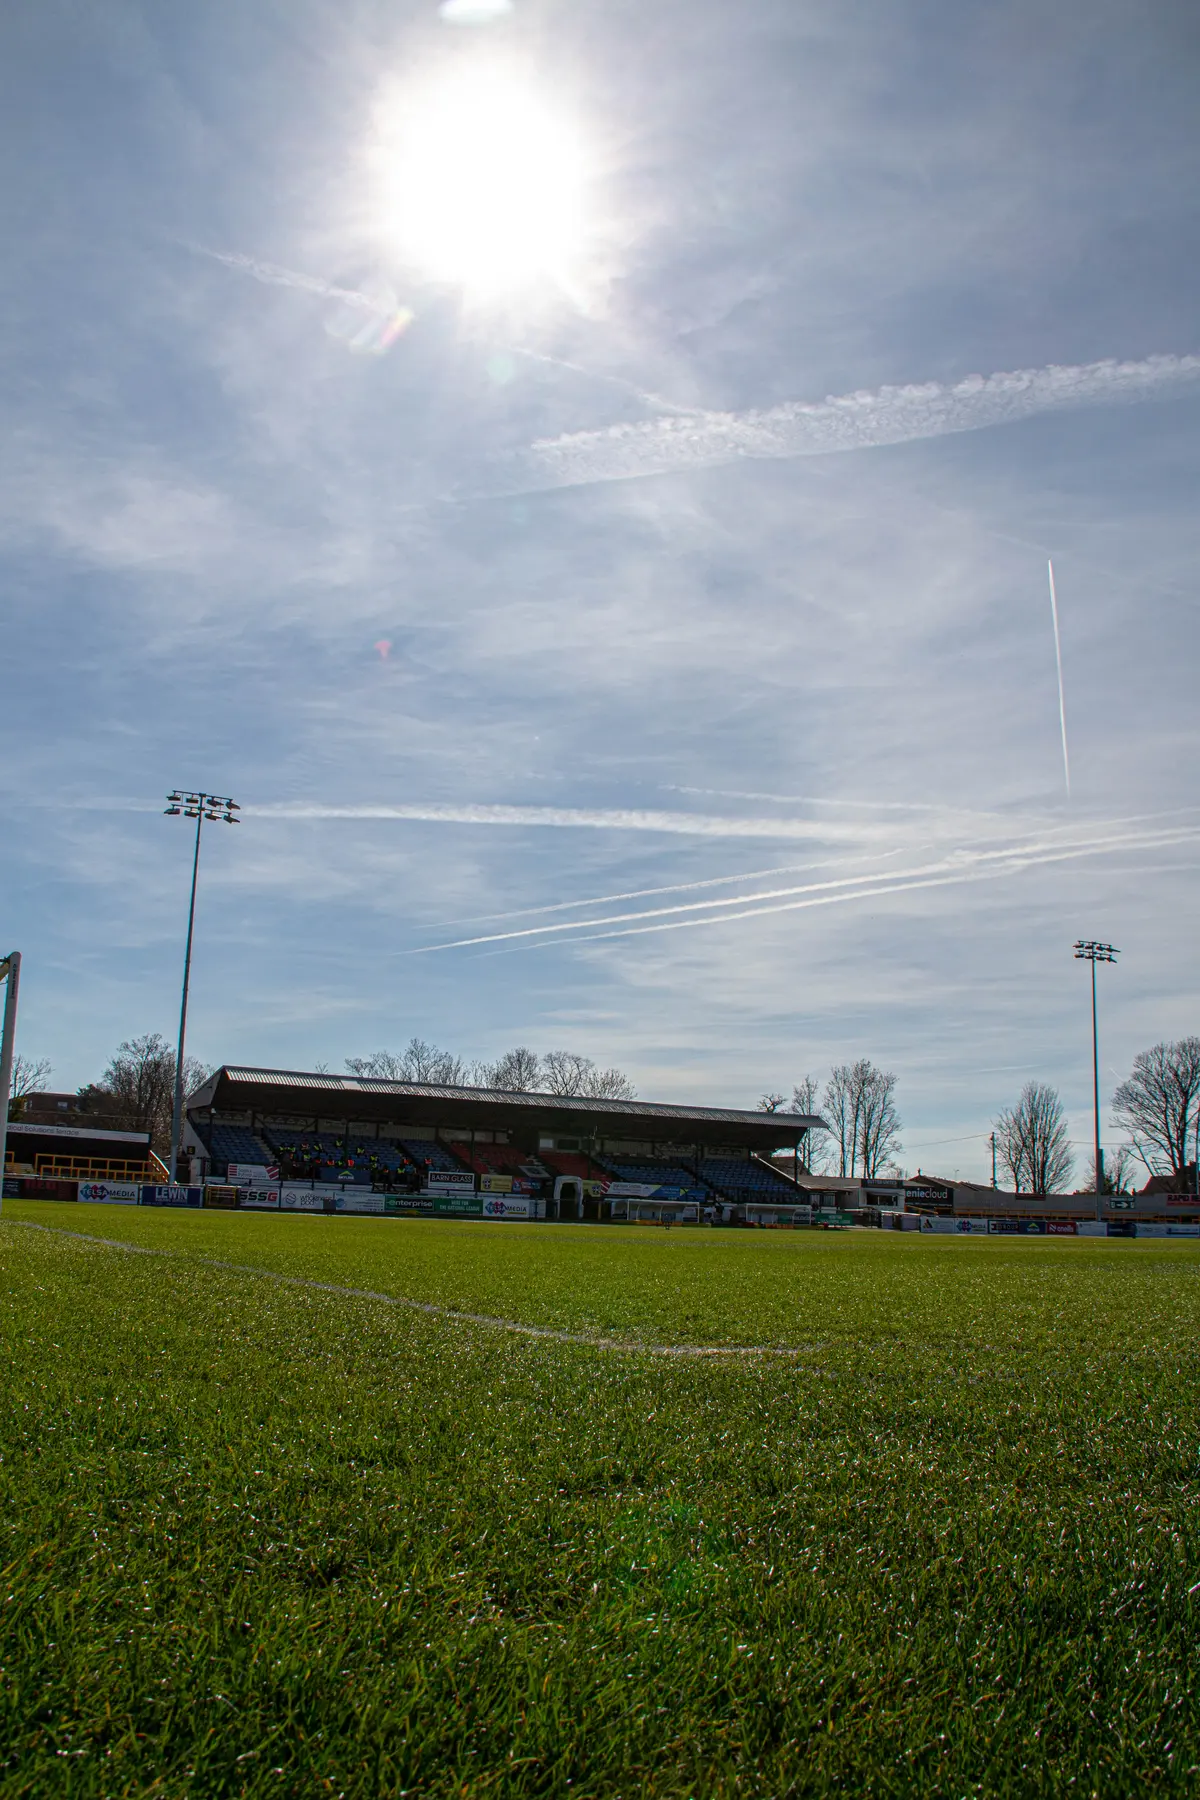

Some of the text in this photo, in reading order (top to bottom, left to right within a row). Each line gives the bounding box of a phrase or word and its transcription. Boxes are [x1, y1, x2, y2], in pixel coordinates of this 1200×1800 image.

[56, 1128, 79, 1136] Terrace
[451, 1175, 472, 1183] GLASS
[109, 1189, 136, 1197] MEDIA
[155, 1187, 188, 1200] LEWIN
[906, 1187, 948, 1199] eniecloud
[387, 1199, 433, 1208] enterprise
[507, 1205, 527, 1213] MEDIA
